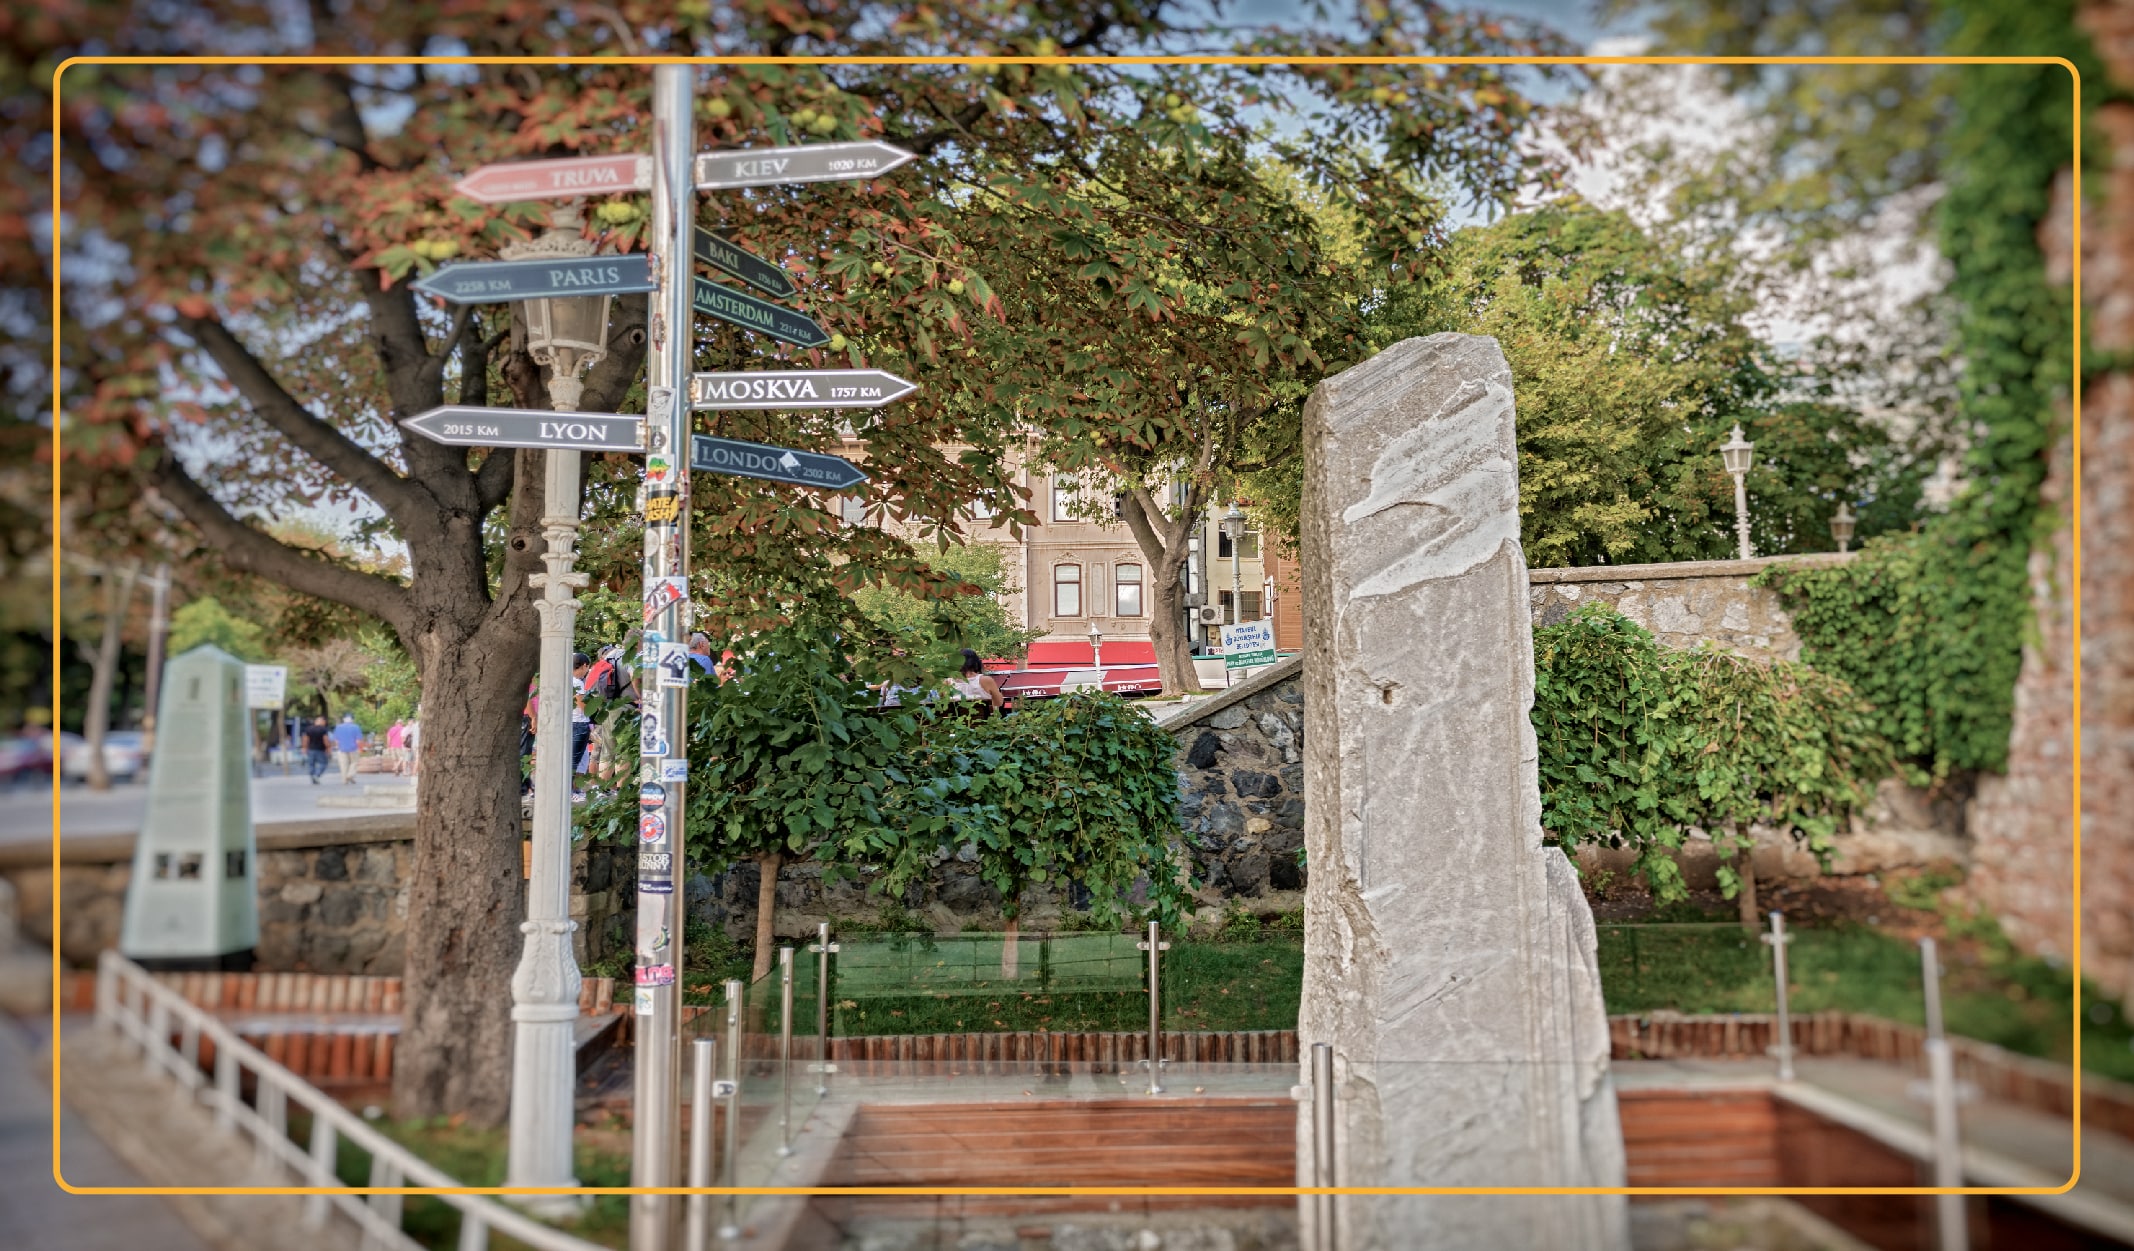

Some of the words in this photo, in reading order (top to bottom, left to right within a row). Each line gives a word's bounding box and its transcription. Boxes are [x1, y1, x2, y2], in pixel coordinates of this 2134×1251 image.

[551, 167, 618, 187] TRUVA
[735, 158, 790, 178] KIEV
[829, 160, 854, 171] 1020
[857, 158, 877, 169] KM
[709, 241, 739, 269] BAKI
[771, 279, 782, 290] KM
[488, 279, 511, 291] KM
[549, 266, 620, 287] PARIS
[695, 287, 774, 328] AMSTERDAM
[798, 328, 812, 340] KM
[704, 378, 819, 400] MOSKVA
[831, 387, 857, 398] 1757
[860, 387, 882, 397] KM
[443, 424, 473, 436] 2015
[477, 425, 499, 437] KM
[539, 422, 608, 442] LYON
[803, 467, 824, 479] 2502
[826, 471, 842, 481] KM
